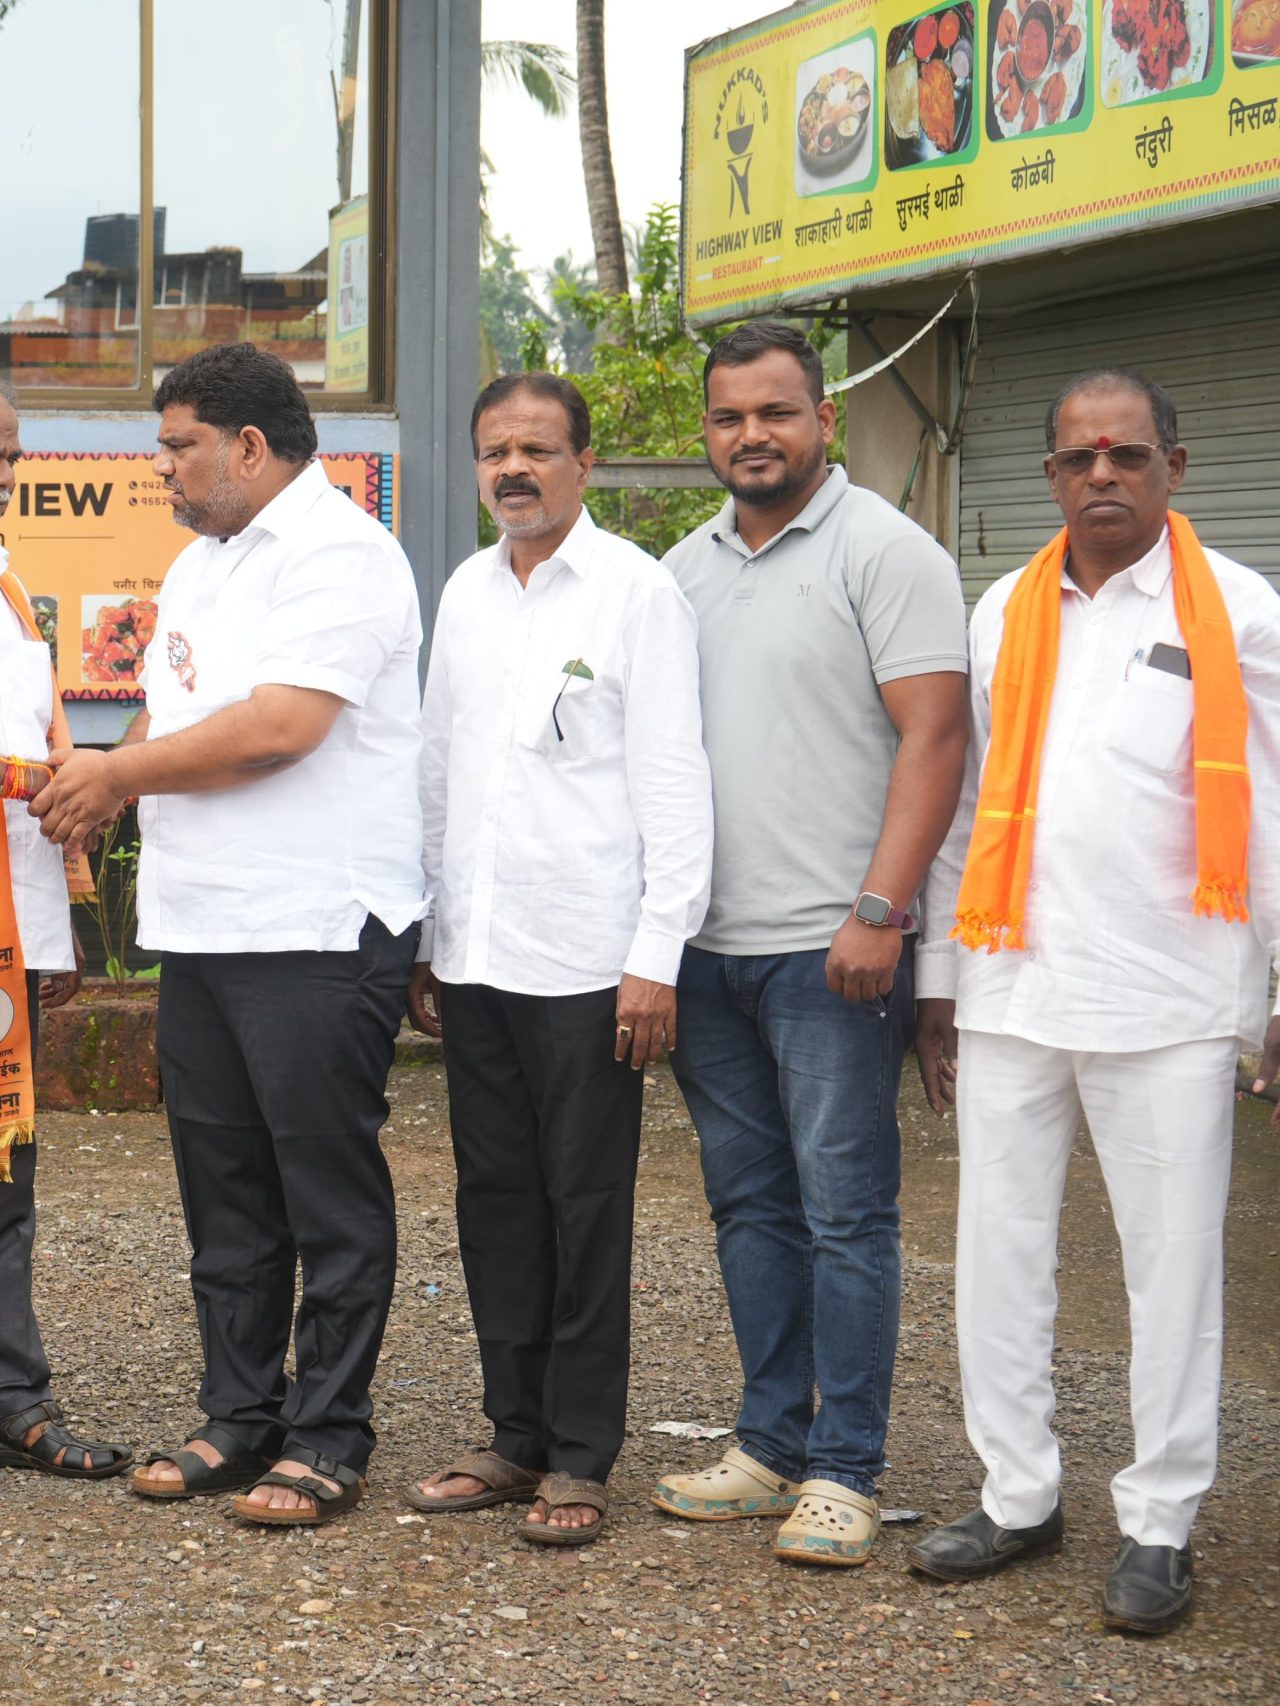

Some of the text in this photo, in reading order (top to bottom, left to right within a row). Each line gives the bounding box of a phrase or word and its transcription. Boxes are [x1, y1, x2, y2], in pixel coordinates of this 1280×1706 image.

[714, 66, 769, 140] NUKKAD'S
[1228, 97, 1278, 137] मिसळ
[1135, 115, 1173, 168] तंदुरी
[1011, 149, 1055, 192] कोळंबी
[795, 199, 873, 248] शाकाहारी थाळी
[896, 174, 964, 231] सुरमई थाळी
[696, 219, 783, 261] HIGHWAY VIEW
[712, 256, 763, 281] RESTAURANT
